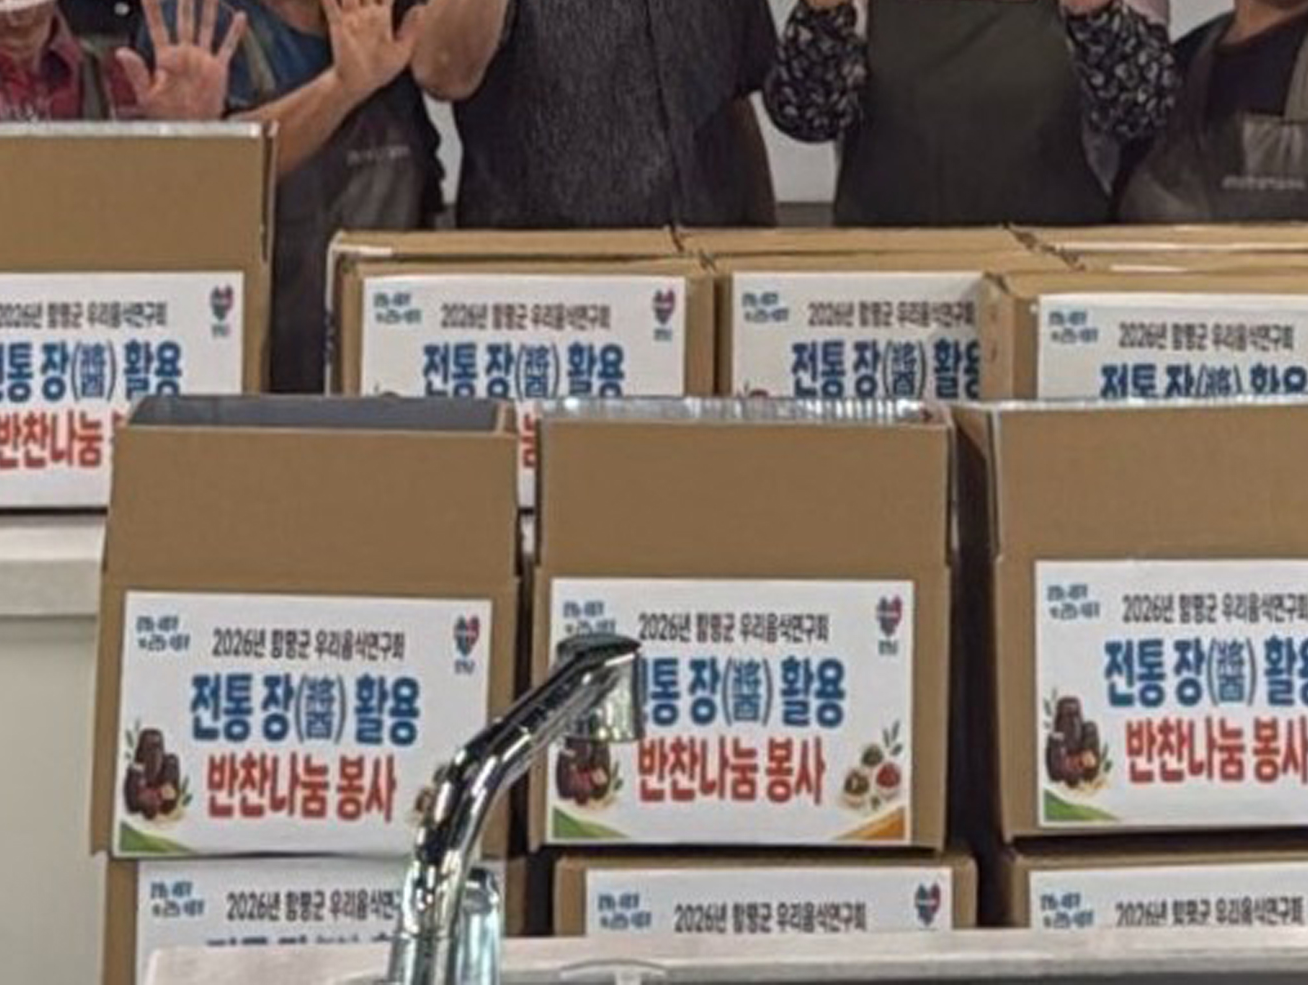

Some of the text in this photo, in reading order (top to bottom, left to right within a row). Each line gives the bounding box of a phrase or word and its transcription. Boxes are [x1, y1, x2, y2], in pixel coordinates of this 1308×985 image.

[423, 342, 478, 398] 전통
[791, 341, 846, 398] 전통
[639, 612, 690, 642] 2026년
[696, 612, 735, 642] 함평군
[1123, 594, 1174, 623] 2026년
[1179, 593, 1217, 623] 함평군
[212, 628, 266, 658] 2026년
[271, 629, 310, 659] 함평군
[1104, 637, 1166, 707] 전통
[191, 672, 253, 742] 전통
[354, 674, 420, 746] 활용
[643, 656, 680, 726] 통
[780, 655, 846, 728] 활용
[639, 735, 826, 805] 반찬나눔 봉사
[1126, 715, 1246, 784] 반찬나눔
[207, 752, 397, 823] 반찬나눔 봉사
[330, 888, 401, 921] 우리음식연
